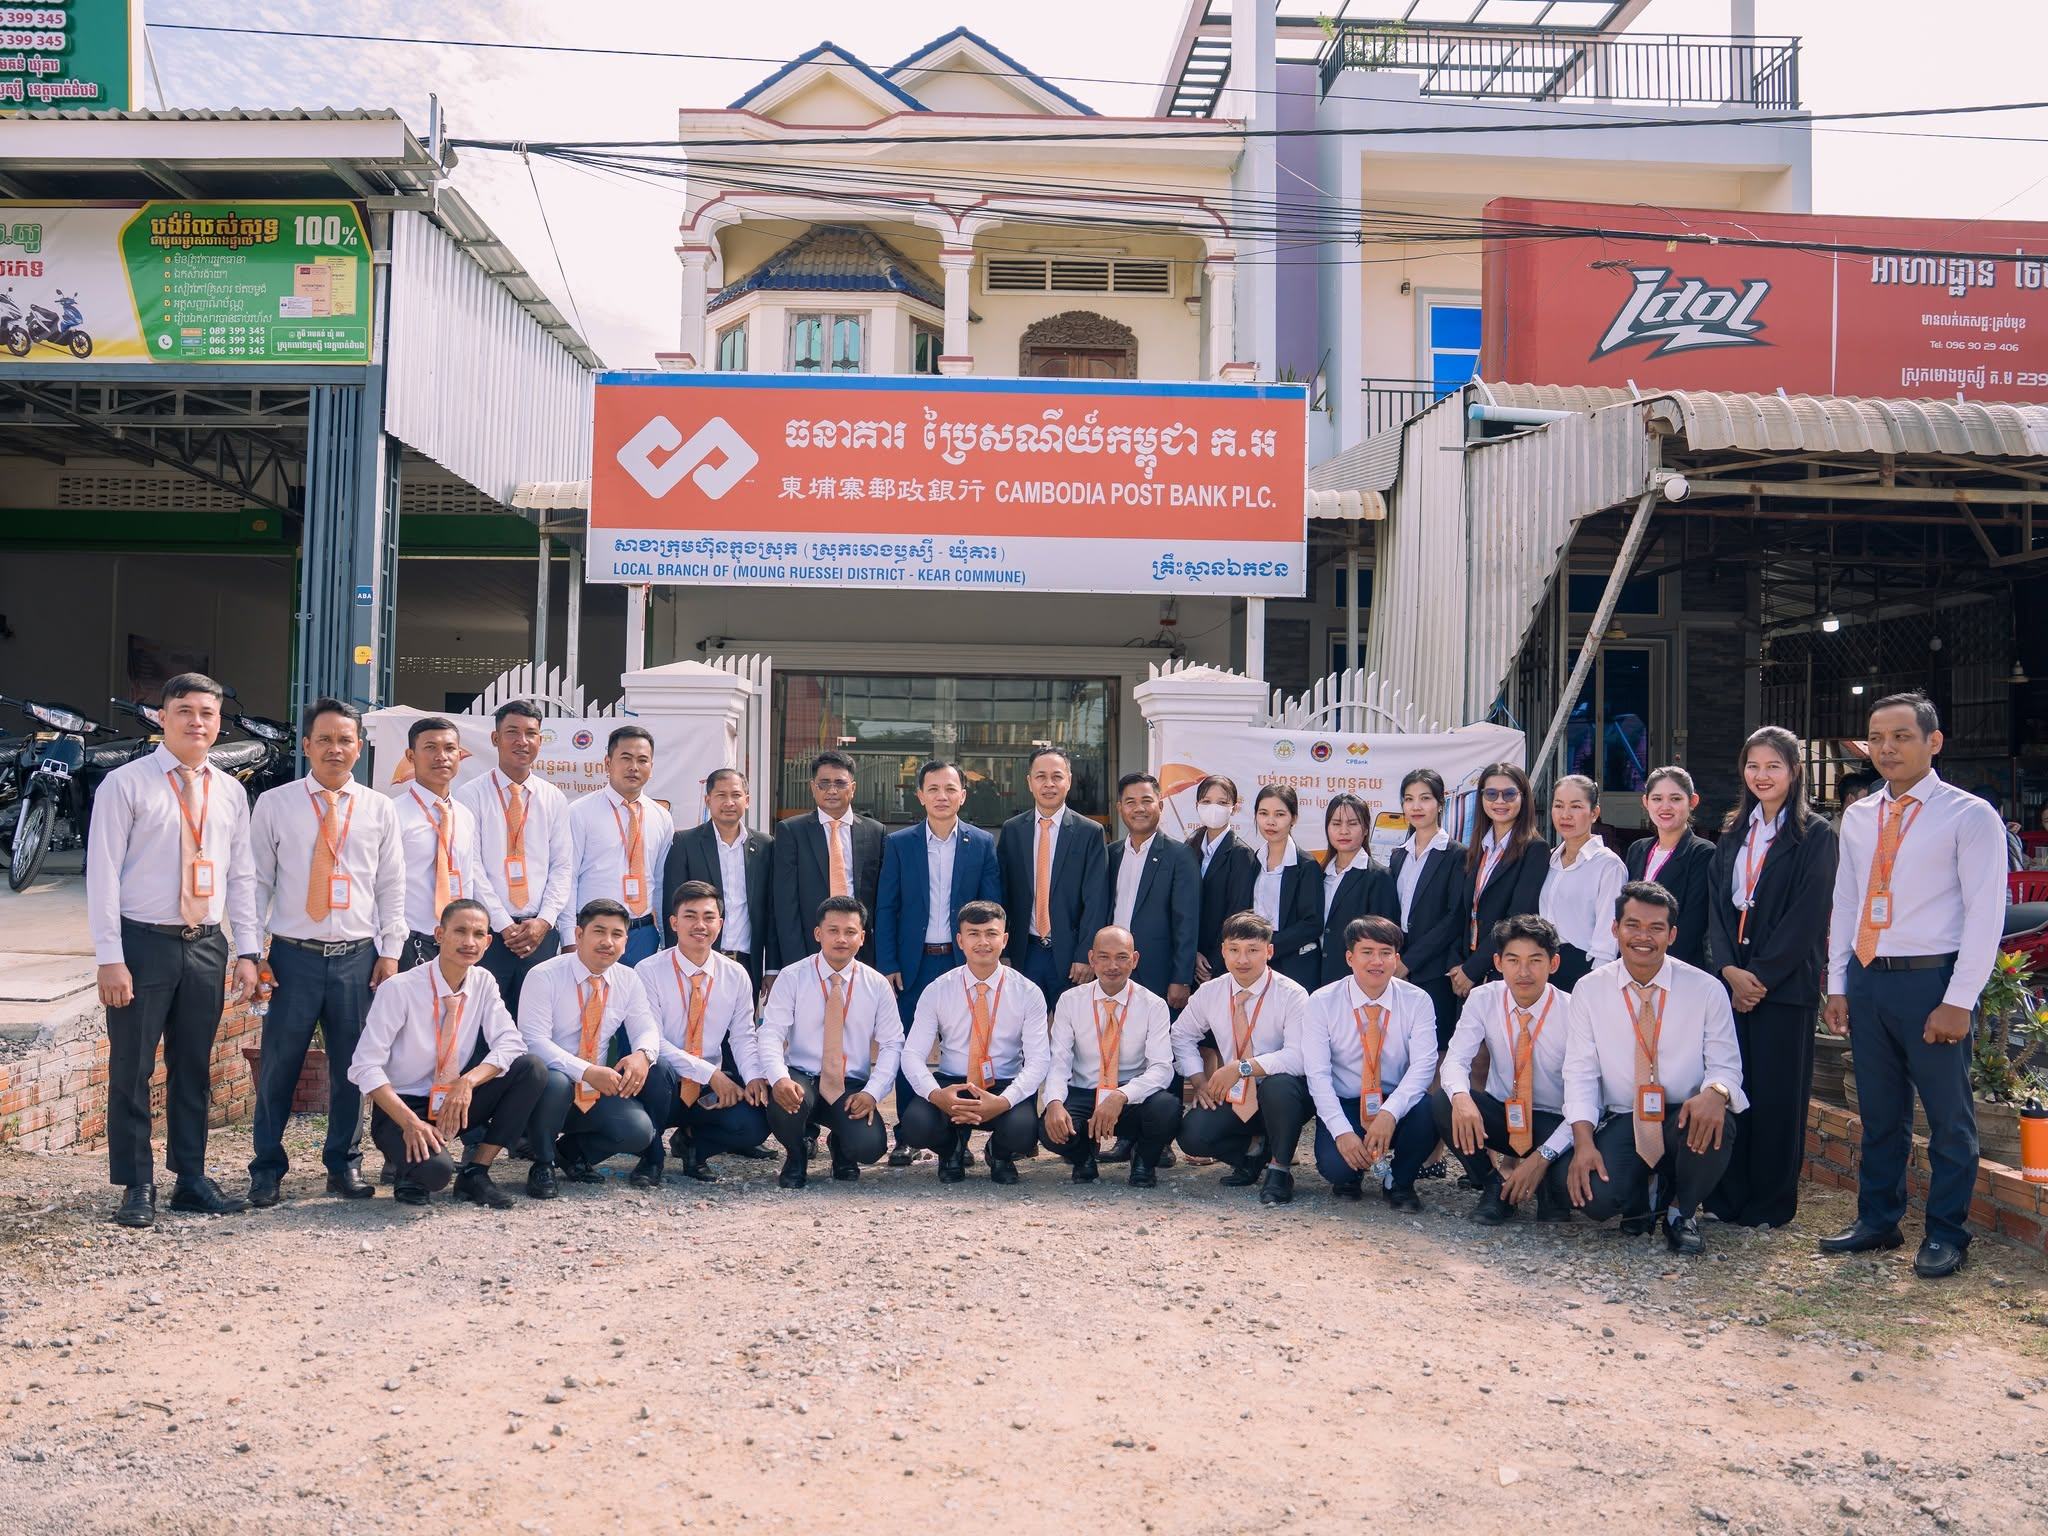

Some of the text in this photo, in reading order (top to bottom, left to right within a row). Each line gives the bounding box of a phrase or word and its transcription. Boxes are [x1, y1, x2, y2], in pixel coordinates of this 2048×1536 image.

[7, 12, 33, 23] 399
[36, 13, 63, 24] 345
[7, 34, 33, 46] 399
[36, 35, 63, 47] 345
[294, 215, 358, 246] 100%
[209, 327, 226, 335] 089
[229, 327, 246, 335] 399
[248, 327, 265, 335] 345
[209, 336, 226, 345] 066
[229, 336, 246, 345] 399
[248, 336, 265, 345] 345
[1945, 341, 1966, 349] 096
[1968, 342, 1982, 350] 90
[1984, 343, 1997, 351] 29
[2000, 343, 2019, 352] 406
[209, 346, 226, 355] 086
[229, 346, 246, 355] 399
[248, 346, 265, 355] 345
[785, 419, 907, 450] ធនាគារ
[995, 480, 1106, 506] CAMBODIA
[1110, 482, 1165, 507] POST
[1169, 483, 1228, 508] BANK
[1232, 485, 1277, 509] PLC.
[613, 562, 653, 576] LOCAL
[657, 563, 708, 577] BRANCH
[713, 564, 730, 577] OF
[733, 564, 785, 580] (MOUNG
[789, 566, 843, 579] RUESSEI
[847, 567, 905, 581] DISTRICT
[918, 568, 951, 582] KEAR
[955, 569, 1026, 585] COMMUNE)
